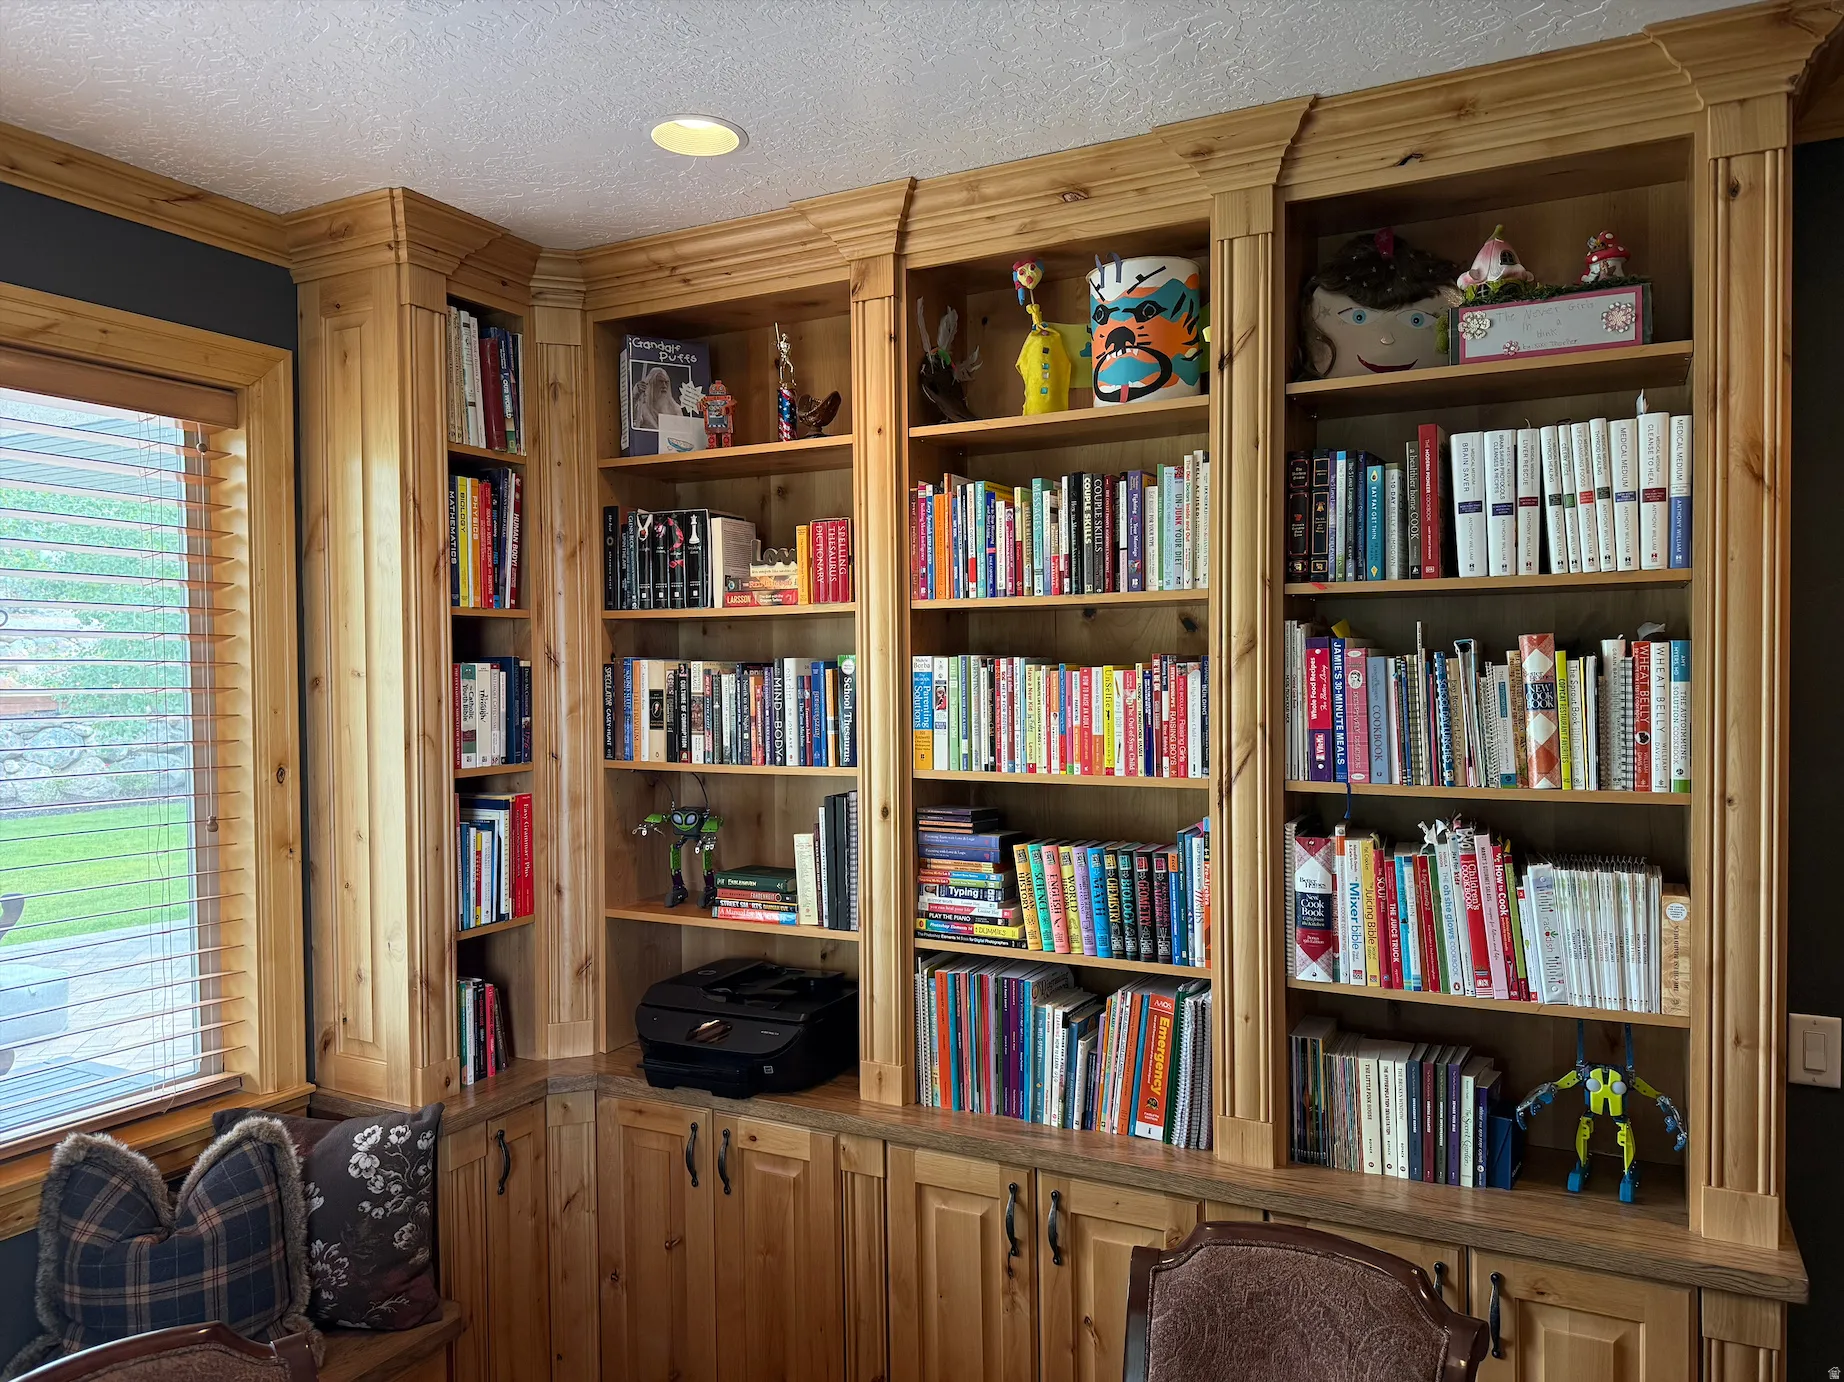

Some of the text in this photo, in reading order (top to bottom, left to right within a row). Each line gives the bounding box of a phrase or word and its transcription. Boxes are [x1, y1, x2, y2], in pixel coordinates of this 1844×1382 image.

[631, 337, 682, 353] Gandalf
[658, 351, 698, 364] Puffs
[1409, 455, 1418, 488] healthier
[1621, 459, 1629, 488] MEDIUM
[1647, 457, 1654, 466] TO
[1033, 483, 1041, 531] MESSAGES
[1094, 479, 1102, 552] COUPLE SKILLS
[1410, 489, 1418, 510] home
[449, 491, 457, 564] MATHEMATICS
[1410, 512, 1419, 540] COOK
[815, 525, 824, 583] DICTIONARY
[828, 526, 837, 582] THESAURUS
[838, 526, 846, 575] SPELLING
[727, 596, 751, 604] LARSSON
[604, 667, 612, 706] SPECULATOR
[1309, 657, 1317, 681] Recipes
[1639, 645, 1650, 724] WHEAT BELLY
[922, 685, 931, 728] Parenting
[1333, 642, 1345, 765] JAMIE'S 30-MINUTE MEALS
[1526, 692, 1554, 700] COOK
[1527, 700, 1554, 709] BOOK
[1529, 684, 1551, 693] NEW
[1570, 681, 1579, 705] Sprout
[1656, 647, 1665, 733] WHEAT BELLY
[843, 677, 853, 762] School Thesaurus
[1372, 705, 1383, 762] COOKBOOK
[1442, 708, 1450, 725] DAY
[1558, 679, 1569, 764] COPYCAT RESTAURANT FAVORITES
[1572, 707, 1580, 725] Book
[1443, 726, 1453, 763] LUNCHES
[1018, 872, 1029, 911] HISTORY
[1025, 872, 1035, 909] AMERICAN
[1034, 872, 1047, 913] SCIENCE
[1443, 884, 1451, 896] oh
[1461, 864, 1473, 911] COOKBOOK
[1468, 863, 1482, 911] Children's
[1495, 864, 1503, 884] How
[949, 887, 979, 899] Typing
[1050, 874, 1062, 914] ENGLISH
[1068, 875, 1078, 913] WORLD
[1093, 877, 1106, 916] MATH
[1106, 877, 1121, 923] CHEMISTRY
[1121, 879, 1134, 925] BIOLOGY
[1137, 879, 1151, 927] GEOMETRY
[1300, 900, 1325, 909] Cook
[1364, 888, 1375, 920] Juicing
[1444, 897, 1452, 913] she
[1497, 892, 1509, 916] Cook
[929, 912, 942, 920] PLAY
[954, 913, 971, 921] PIANO
[1301, 908, 1325, 917] Book
[1349, 882, 1361, 950] Mixer bible
[1444, 914, 1455, 940] glows
[979, 927, 1006, 936] DUMMIES
[1367, 921, 1377, 945] Bible
[1389, 903, 1400, 963] THE JUICE TRUCK
[1449, 941, 1459, 977] COOKBOOK
[1151, 1015, 1170, 1096] Emergency
